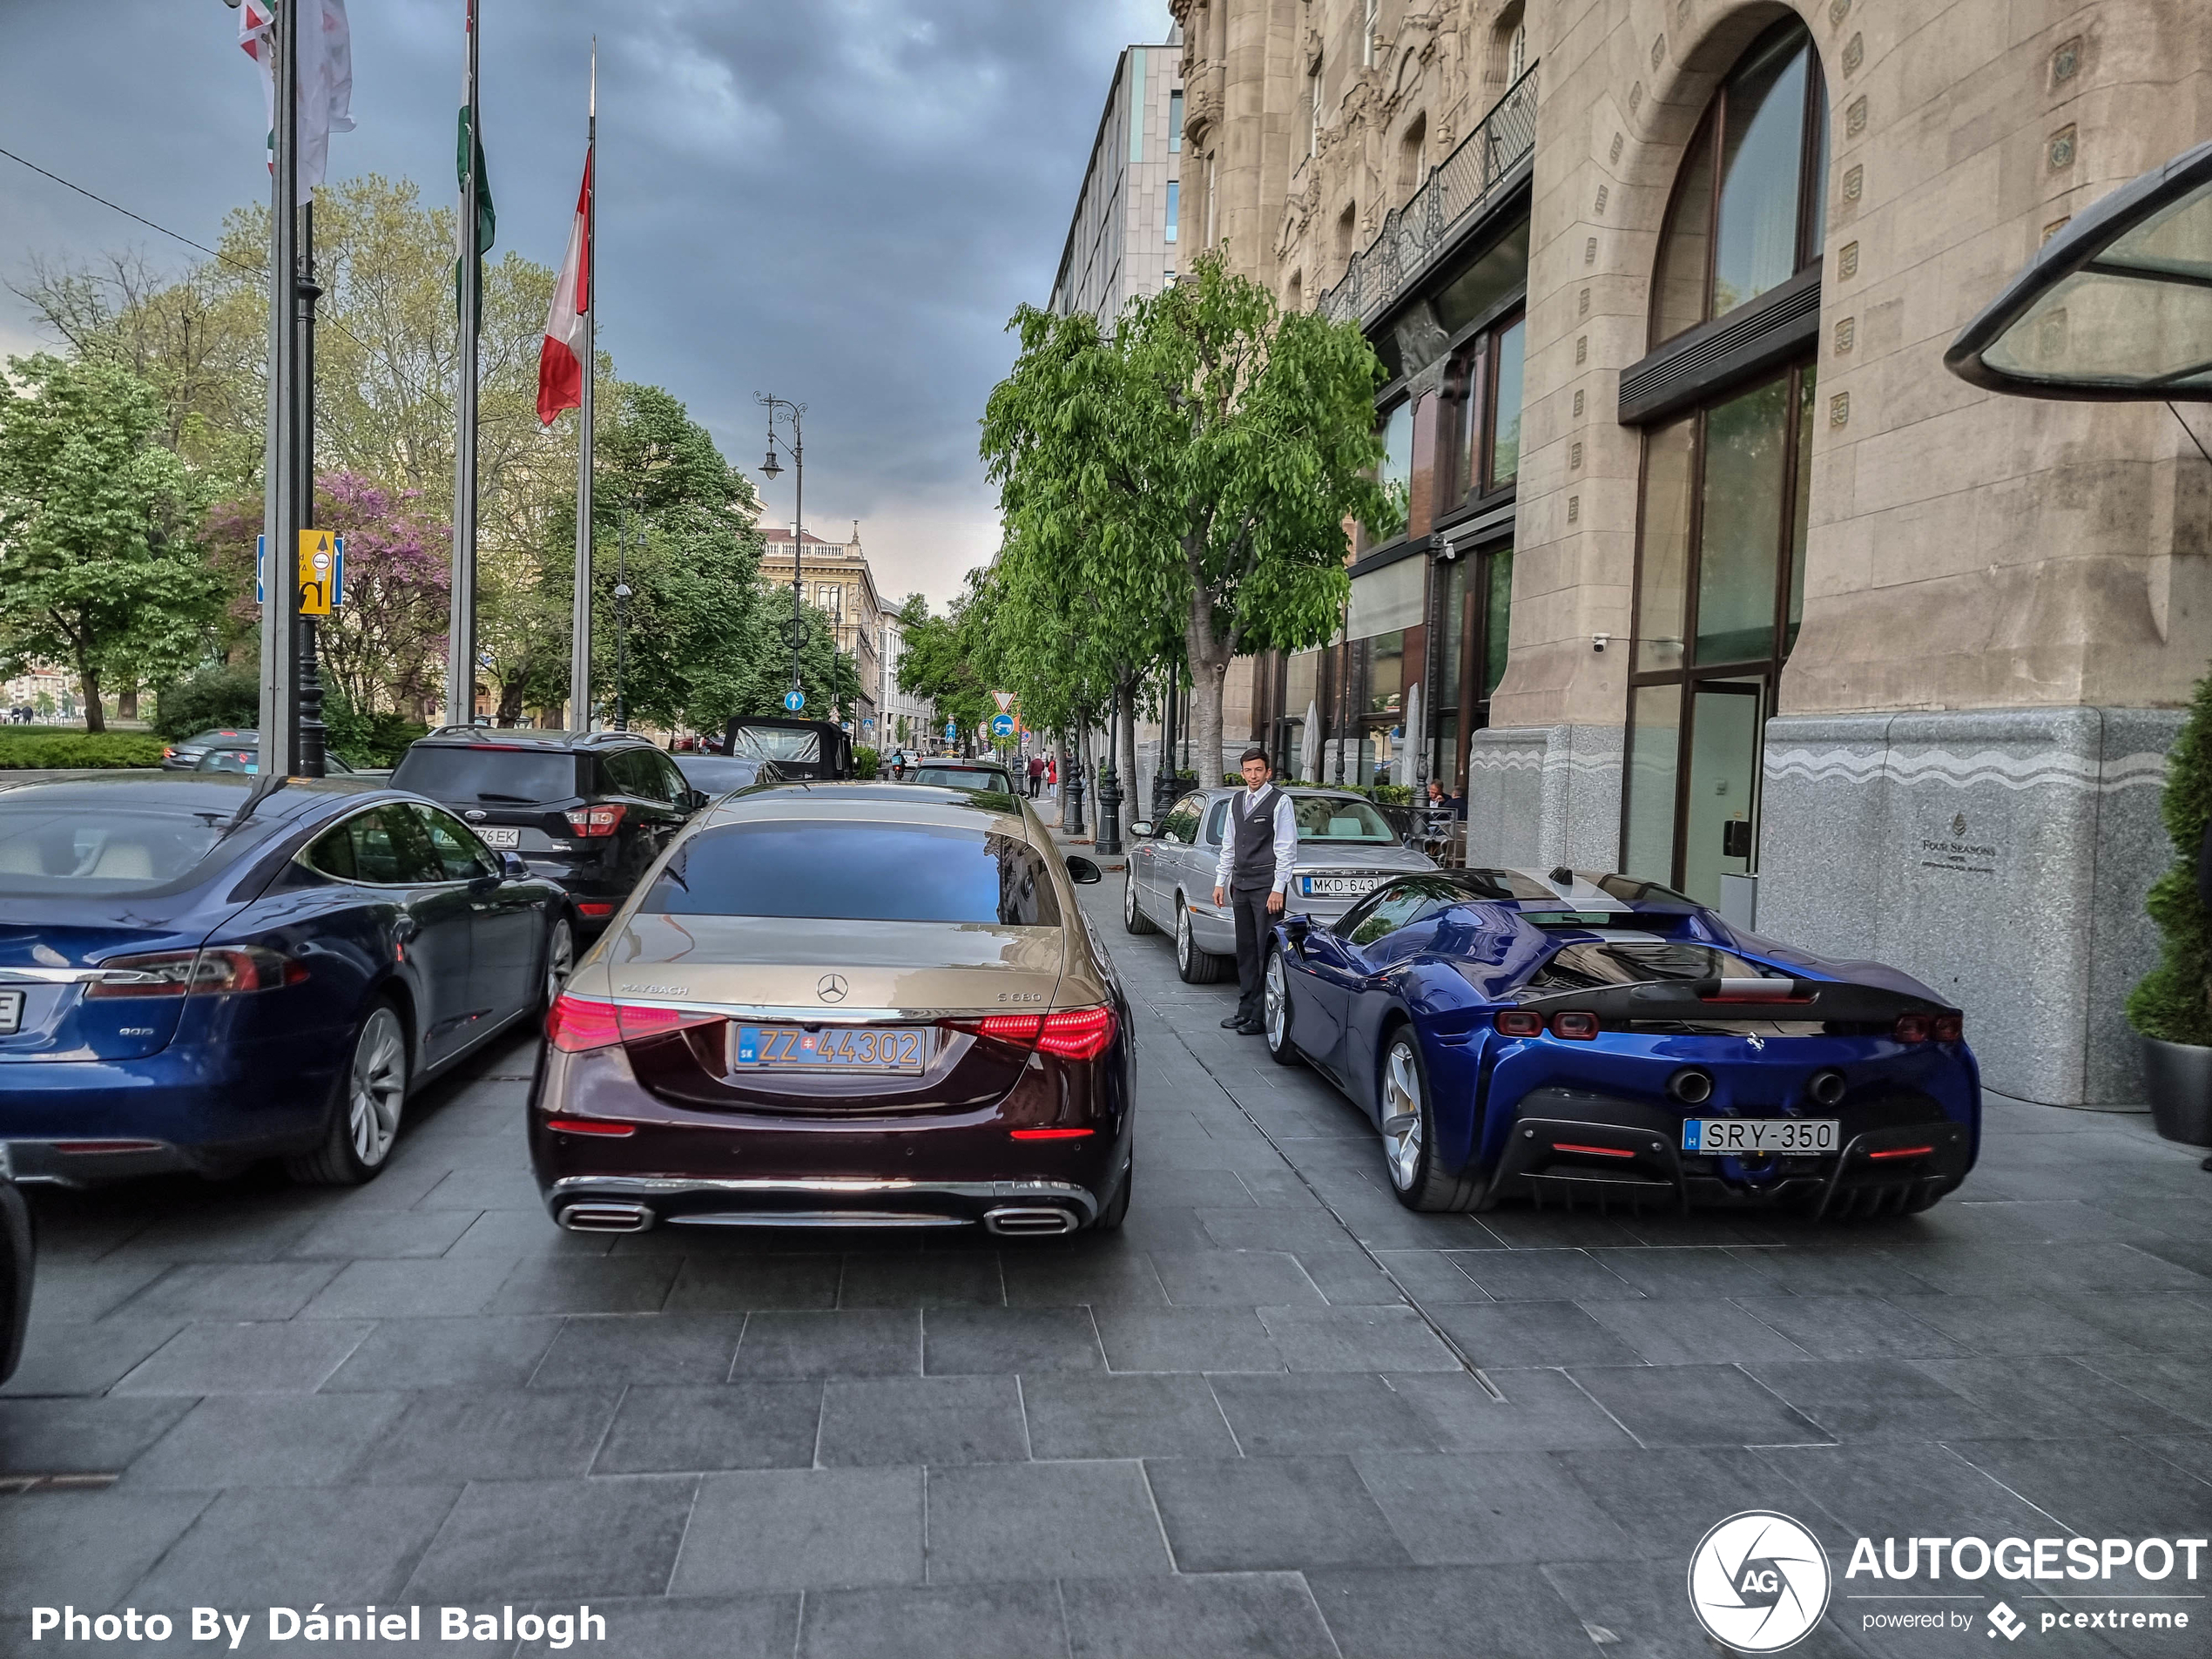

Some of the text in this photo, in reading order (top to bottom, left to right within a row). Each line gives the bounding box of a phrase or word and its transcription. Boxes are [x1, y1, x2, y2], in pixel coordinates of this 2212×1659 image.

[496, 831, 515, 843] EK
[1314, 879, 1374, 892] MKD-643
[621, 983, 689, 995] MAYBACH
[997, 993, 1042, 1002] S 680
[740, 1030, 919, 1064] SK ZZ 44302
[1688, 1123, 1831, 1149] H SRY-350
